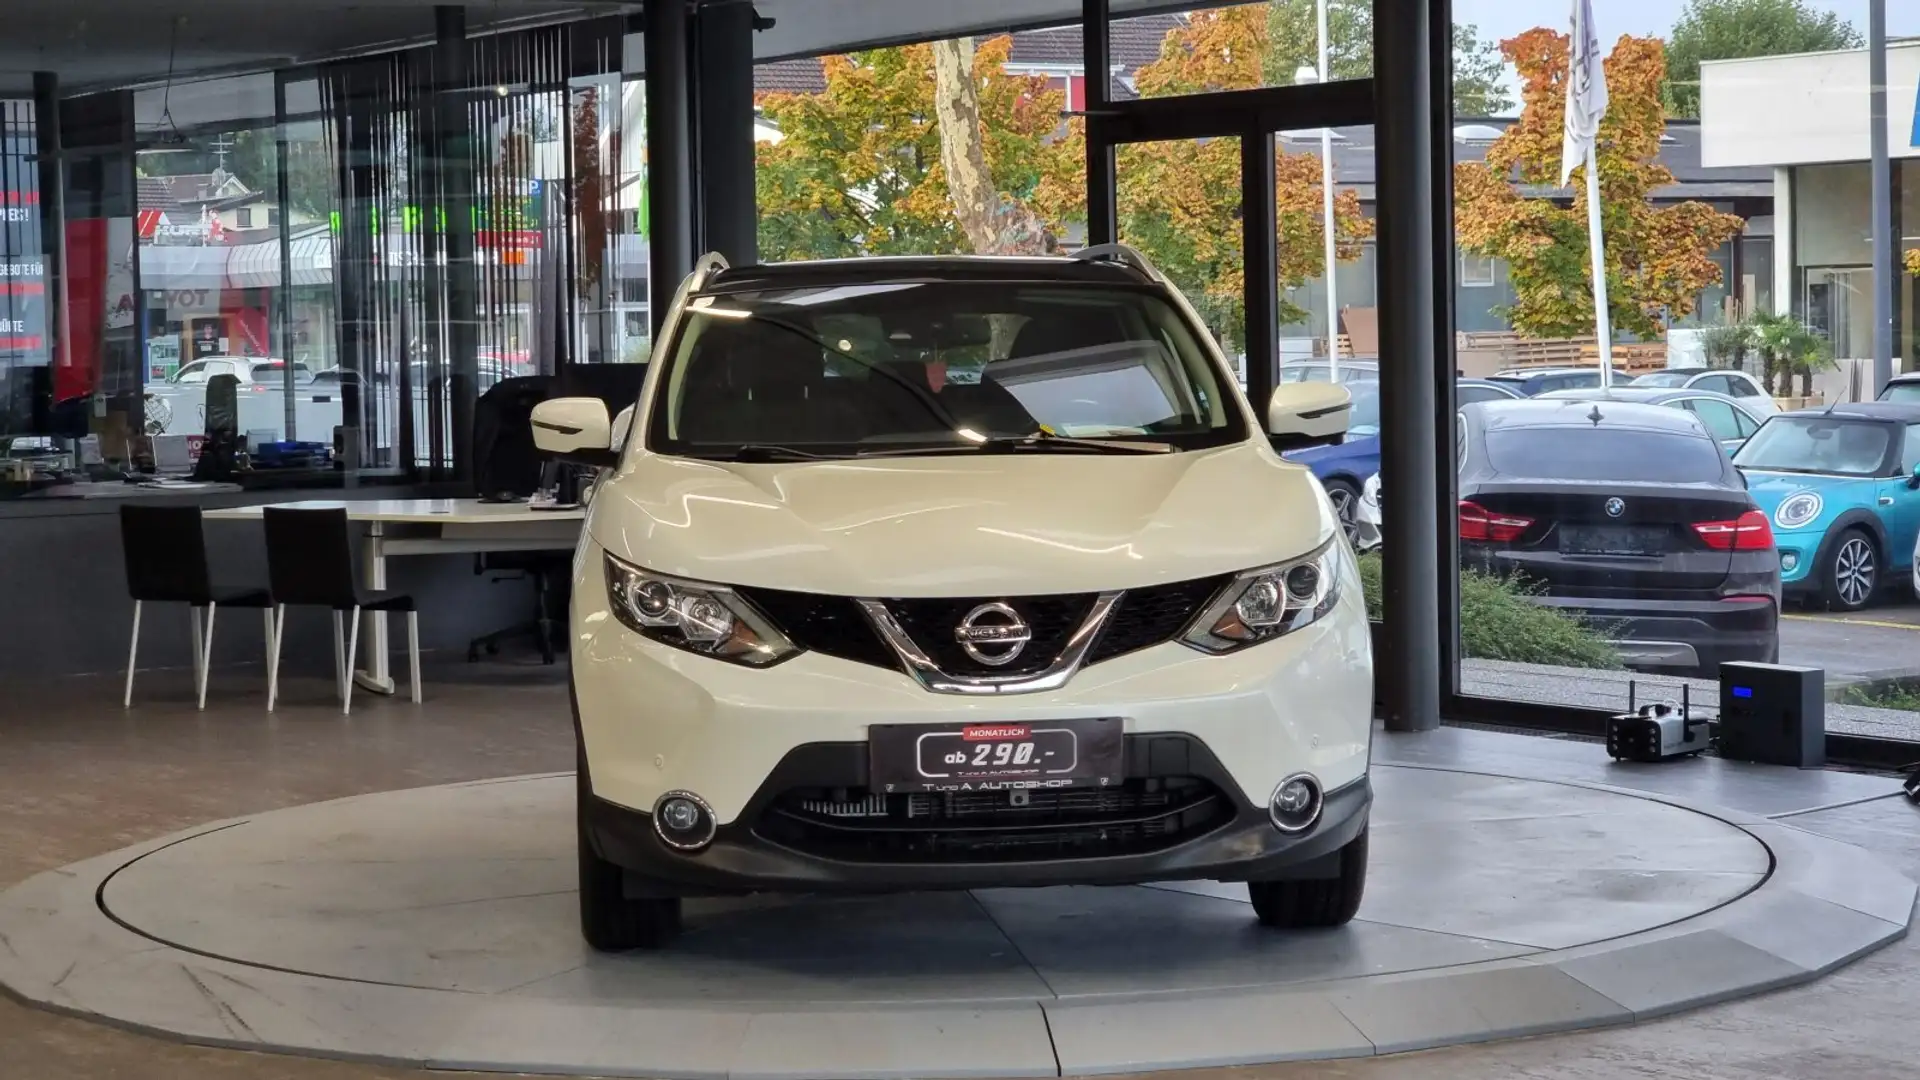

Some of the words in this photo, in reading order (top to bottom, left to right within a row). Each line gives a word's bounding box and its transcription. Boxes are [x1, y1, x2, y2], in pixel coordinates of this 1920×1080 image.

[969, 728, 1025, 737] MONATLICH
[944, 751, 967, 764] ab
[971, 743, 1055, 766] 290.-
[979, 780, 1073, 790] AUTOSHOP
